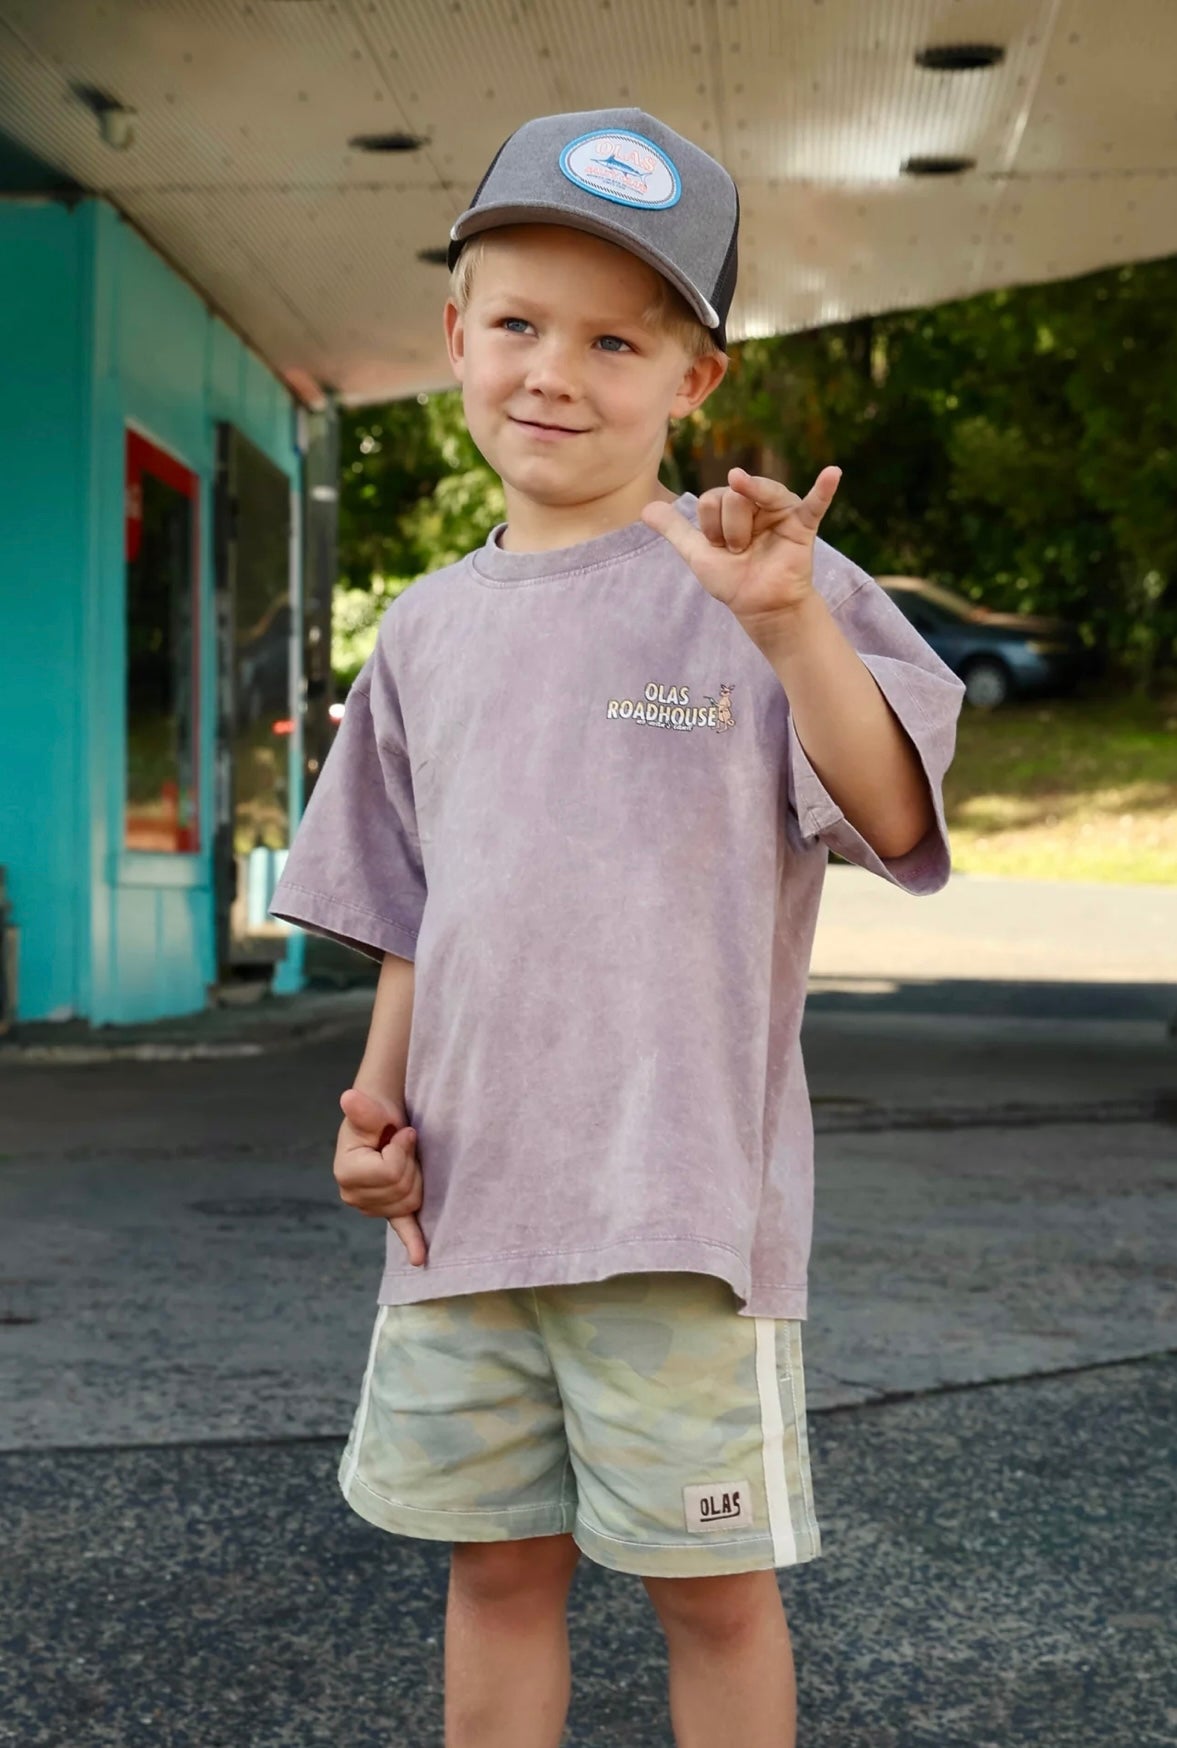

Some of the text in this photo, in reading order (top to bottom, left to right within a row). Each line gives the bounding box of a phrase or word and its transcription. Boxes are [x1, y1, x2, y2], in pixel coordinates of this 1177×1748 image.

[595, 139, 655, 171] OLAS
[645, 683, 689, 705] OLAS
[607, 700, 716, 727] ROADHOUSE
[700, 1490, 741, 1518] OLAS
